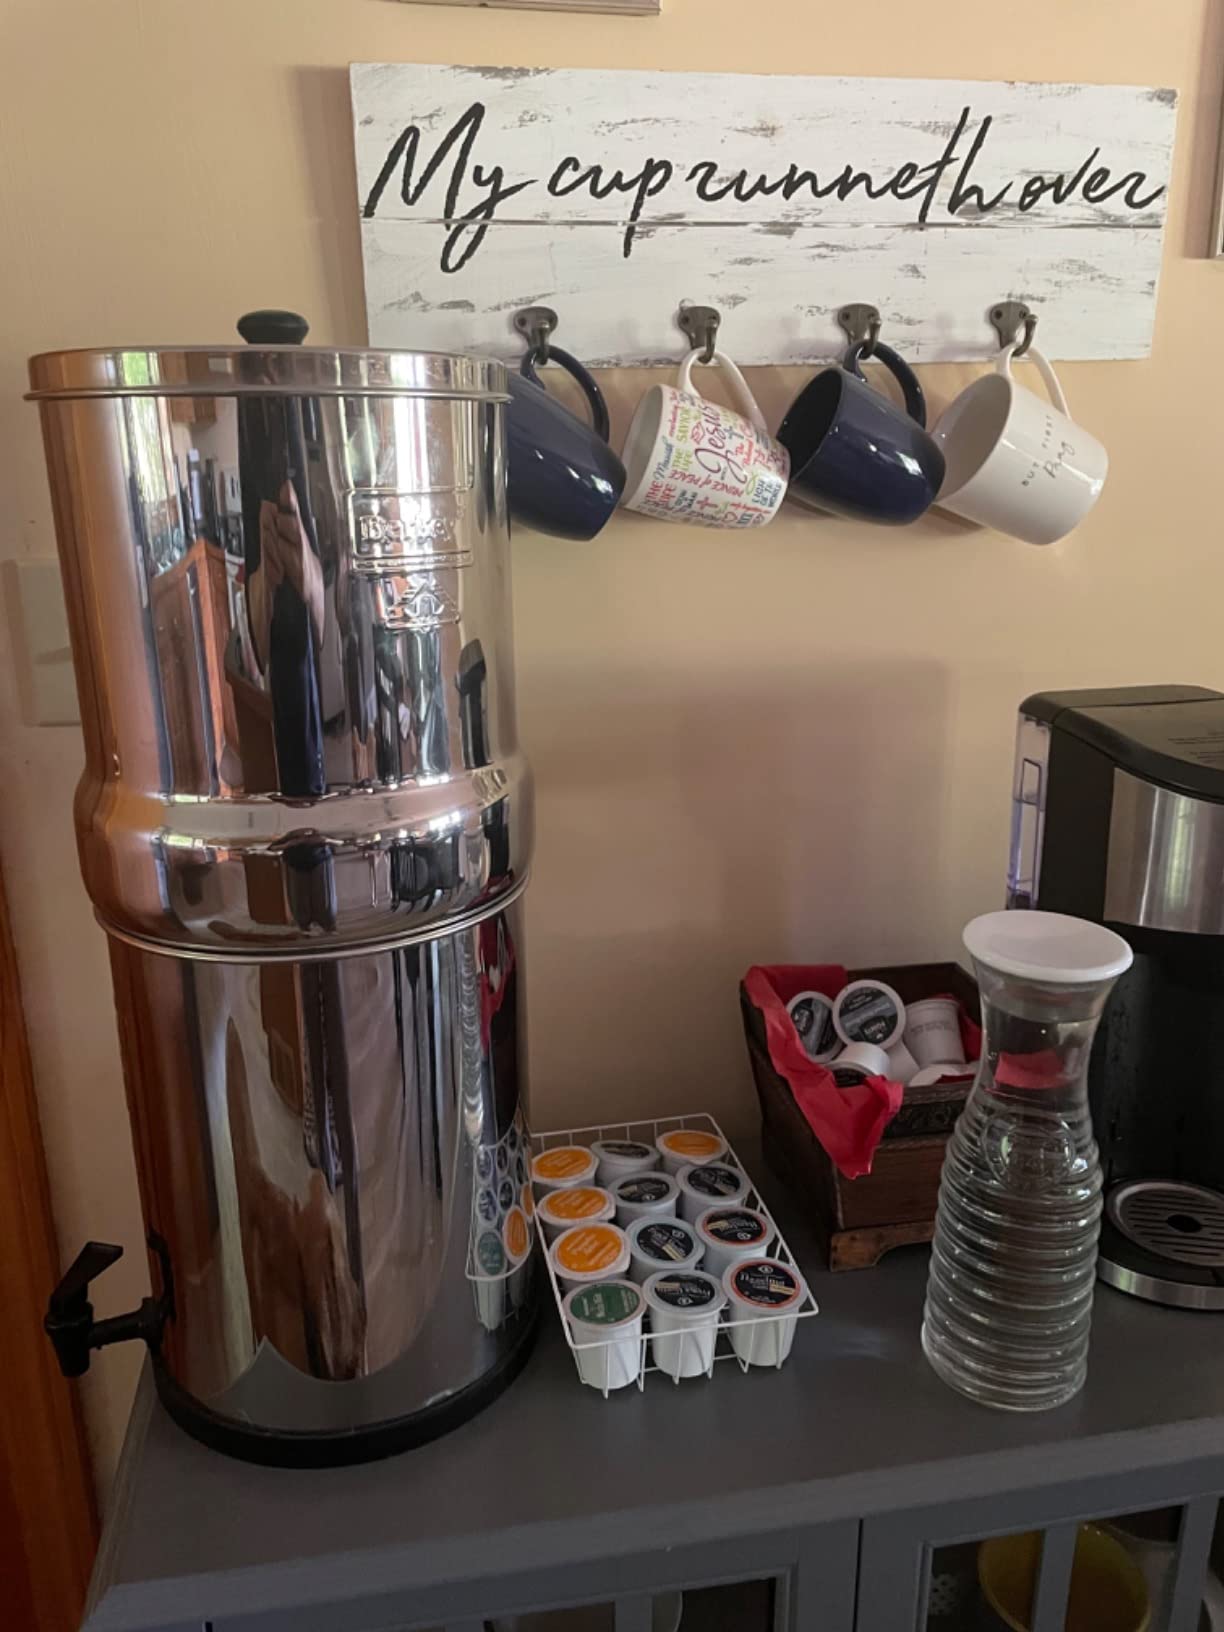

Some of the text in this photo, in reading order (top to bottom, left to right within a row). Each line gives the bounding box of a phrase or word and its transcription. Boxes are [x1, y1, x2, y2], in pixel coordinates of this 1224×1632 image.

[362, 101, 1165, 273] My cup runneth over
[695, 403, 748, 485] Jesus
